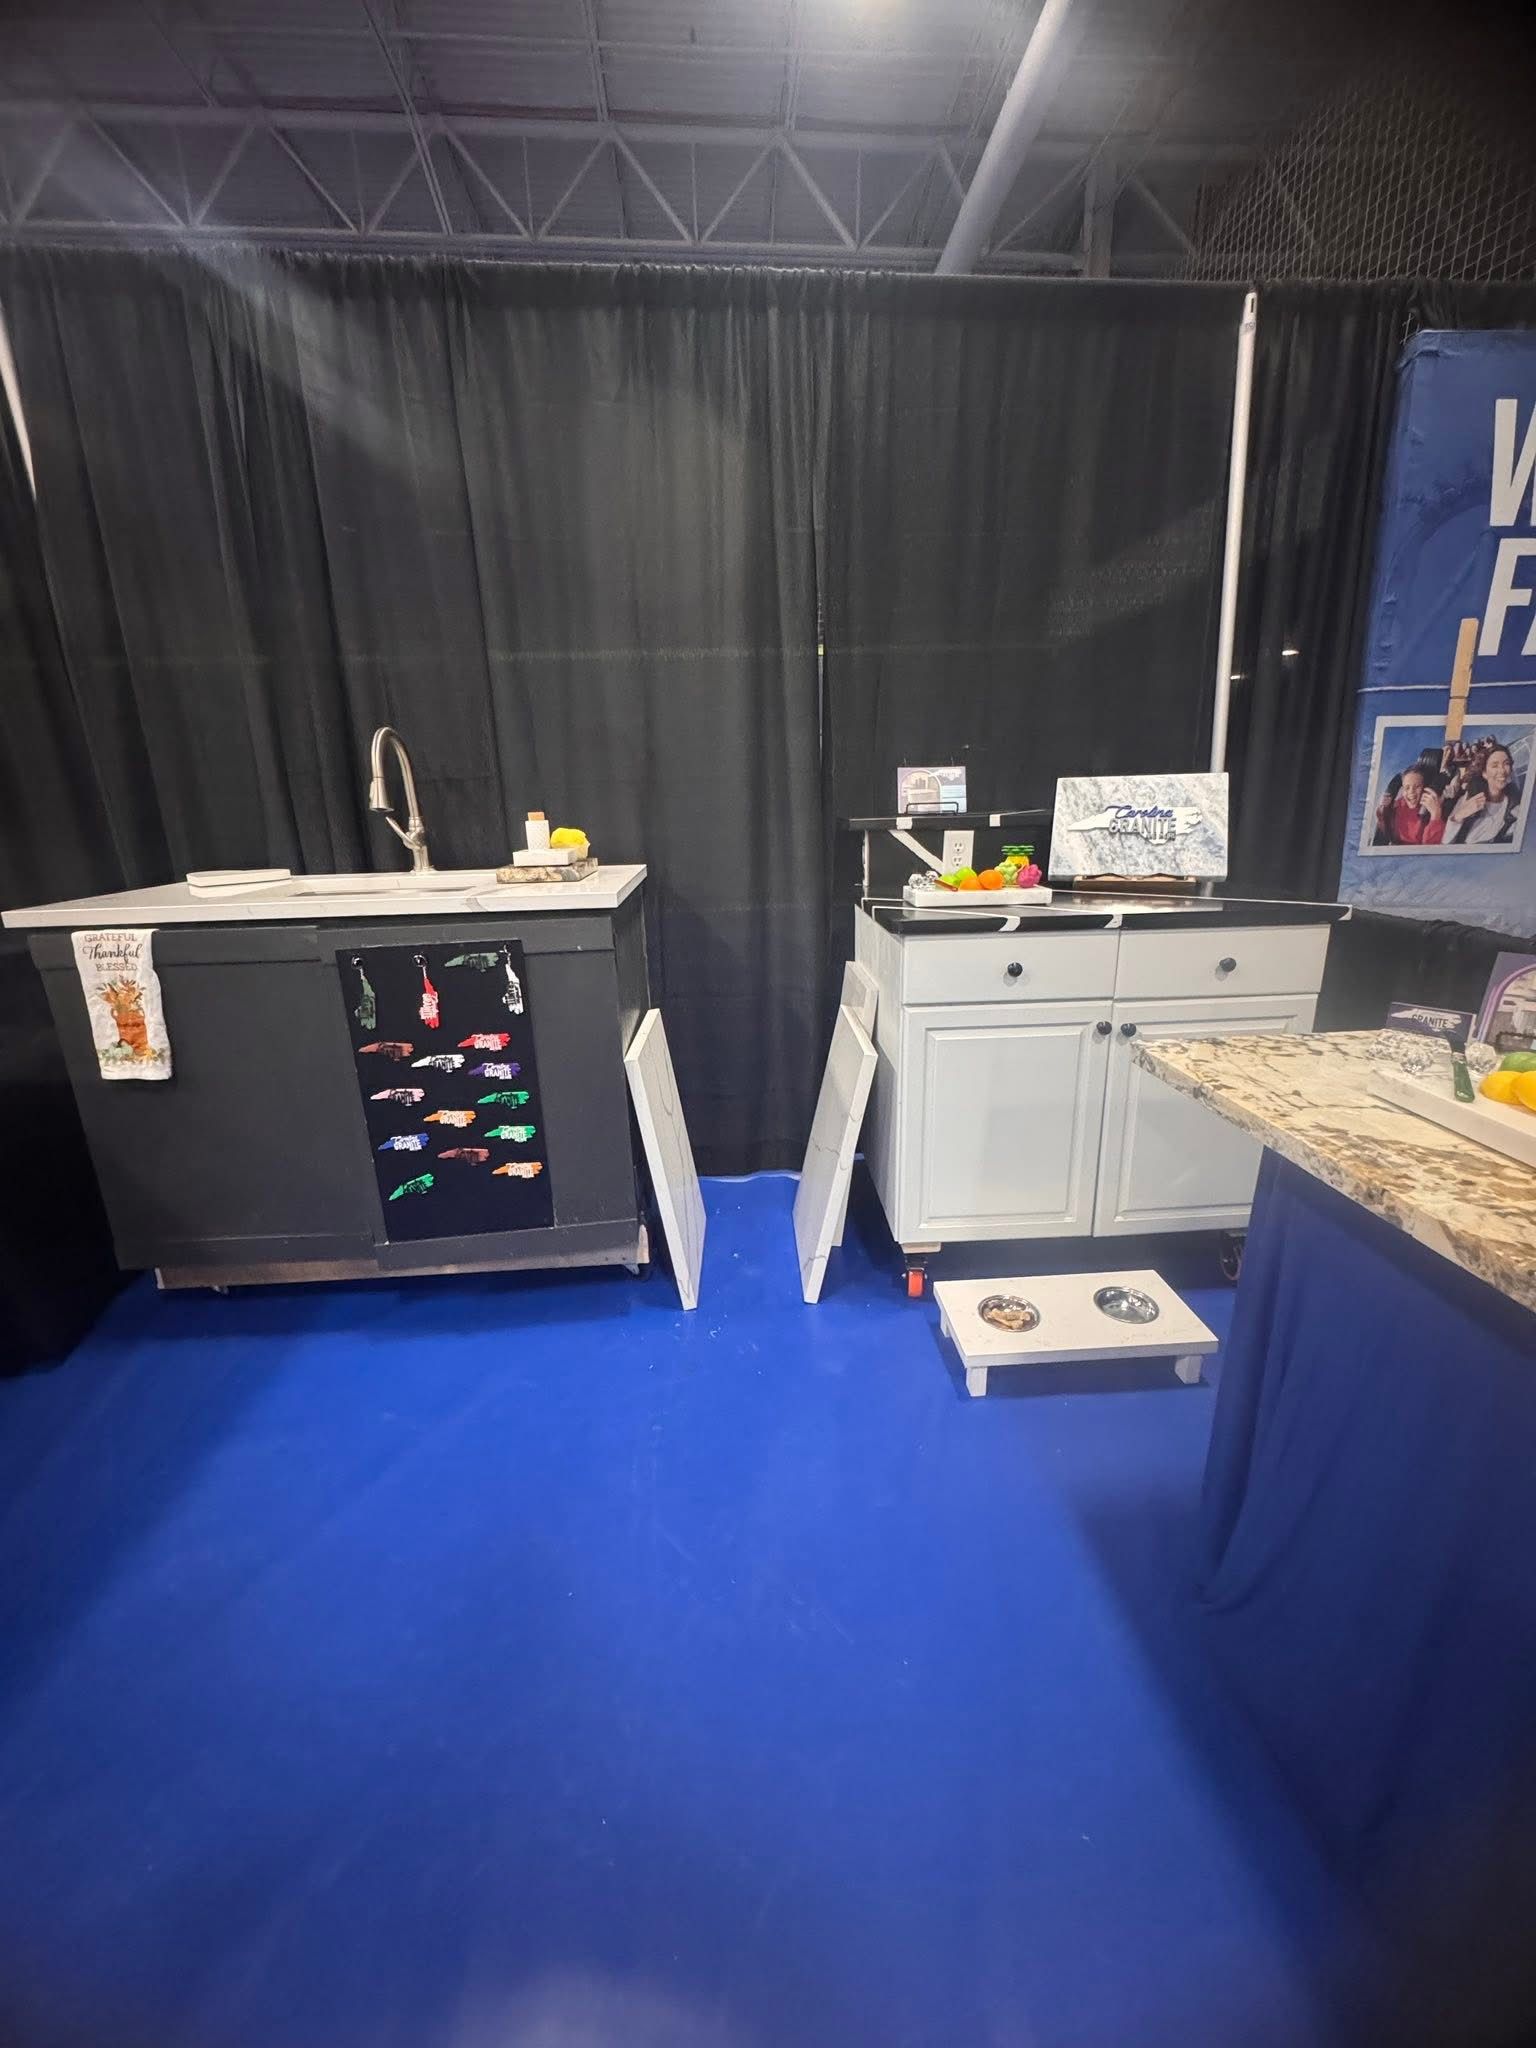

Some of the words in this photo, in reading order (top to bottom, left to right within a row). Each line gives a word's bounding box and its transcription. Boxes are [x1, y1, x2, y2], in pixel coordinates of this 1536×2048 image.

[1105, 805, 1173, 819] Carolina
[1108, 818, 1177, 834] GRANITE
[84, 933, 137, 942] GRATEFUL
[82, 943, 143, 964] Thankful
[96, 962, 138, 972] BLESSED
[1411, 1014, 1449, 1028] GRANITE
